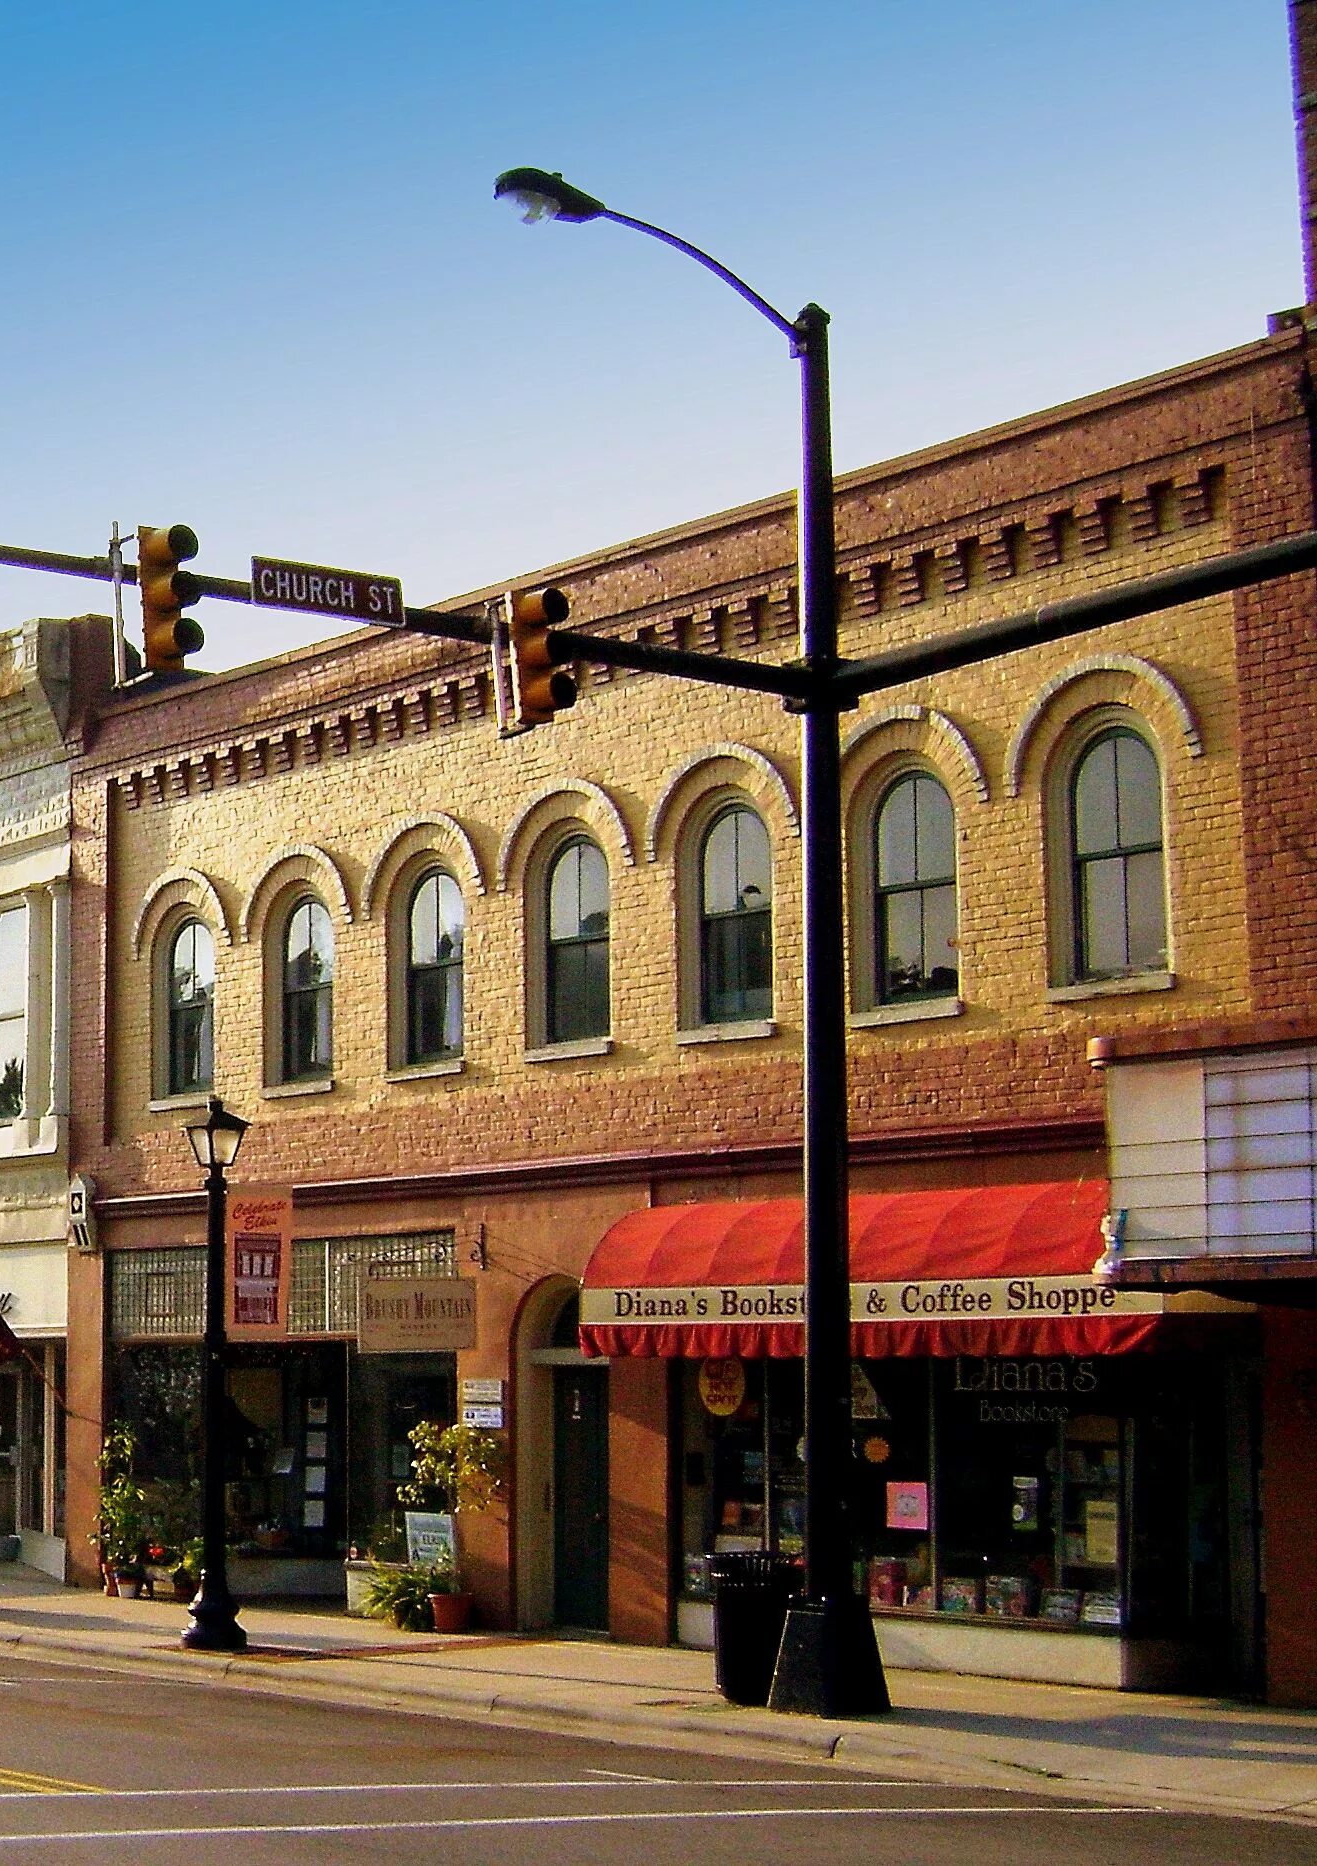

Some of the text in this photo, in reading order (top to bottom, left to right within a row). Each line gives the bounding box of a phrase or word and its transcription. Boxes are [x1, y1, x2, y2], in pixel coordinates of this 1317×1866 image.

[260, 568, 395, 614] CHURCH ST
[613, 1290, 709, 1318] Diana's
[866, 1288, 887, 1314] &
[900, 1284, 993, 1313] Coffee
[1007, 1280, 1117, 1315] Shoppe
[953, 1355, 1099, 1392] Diana's
[979, 1400, 1069, 1423] Bookstore
